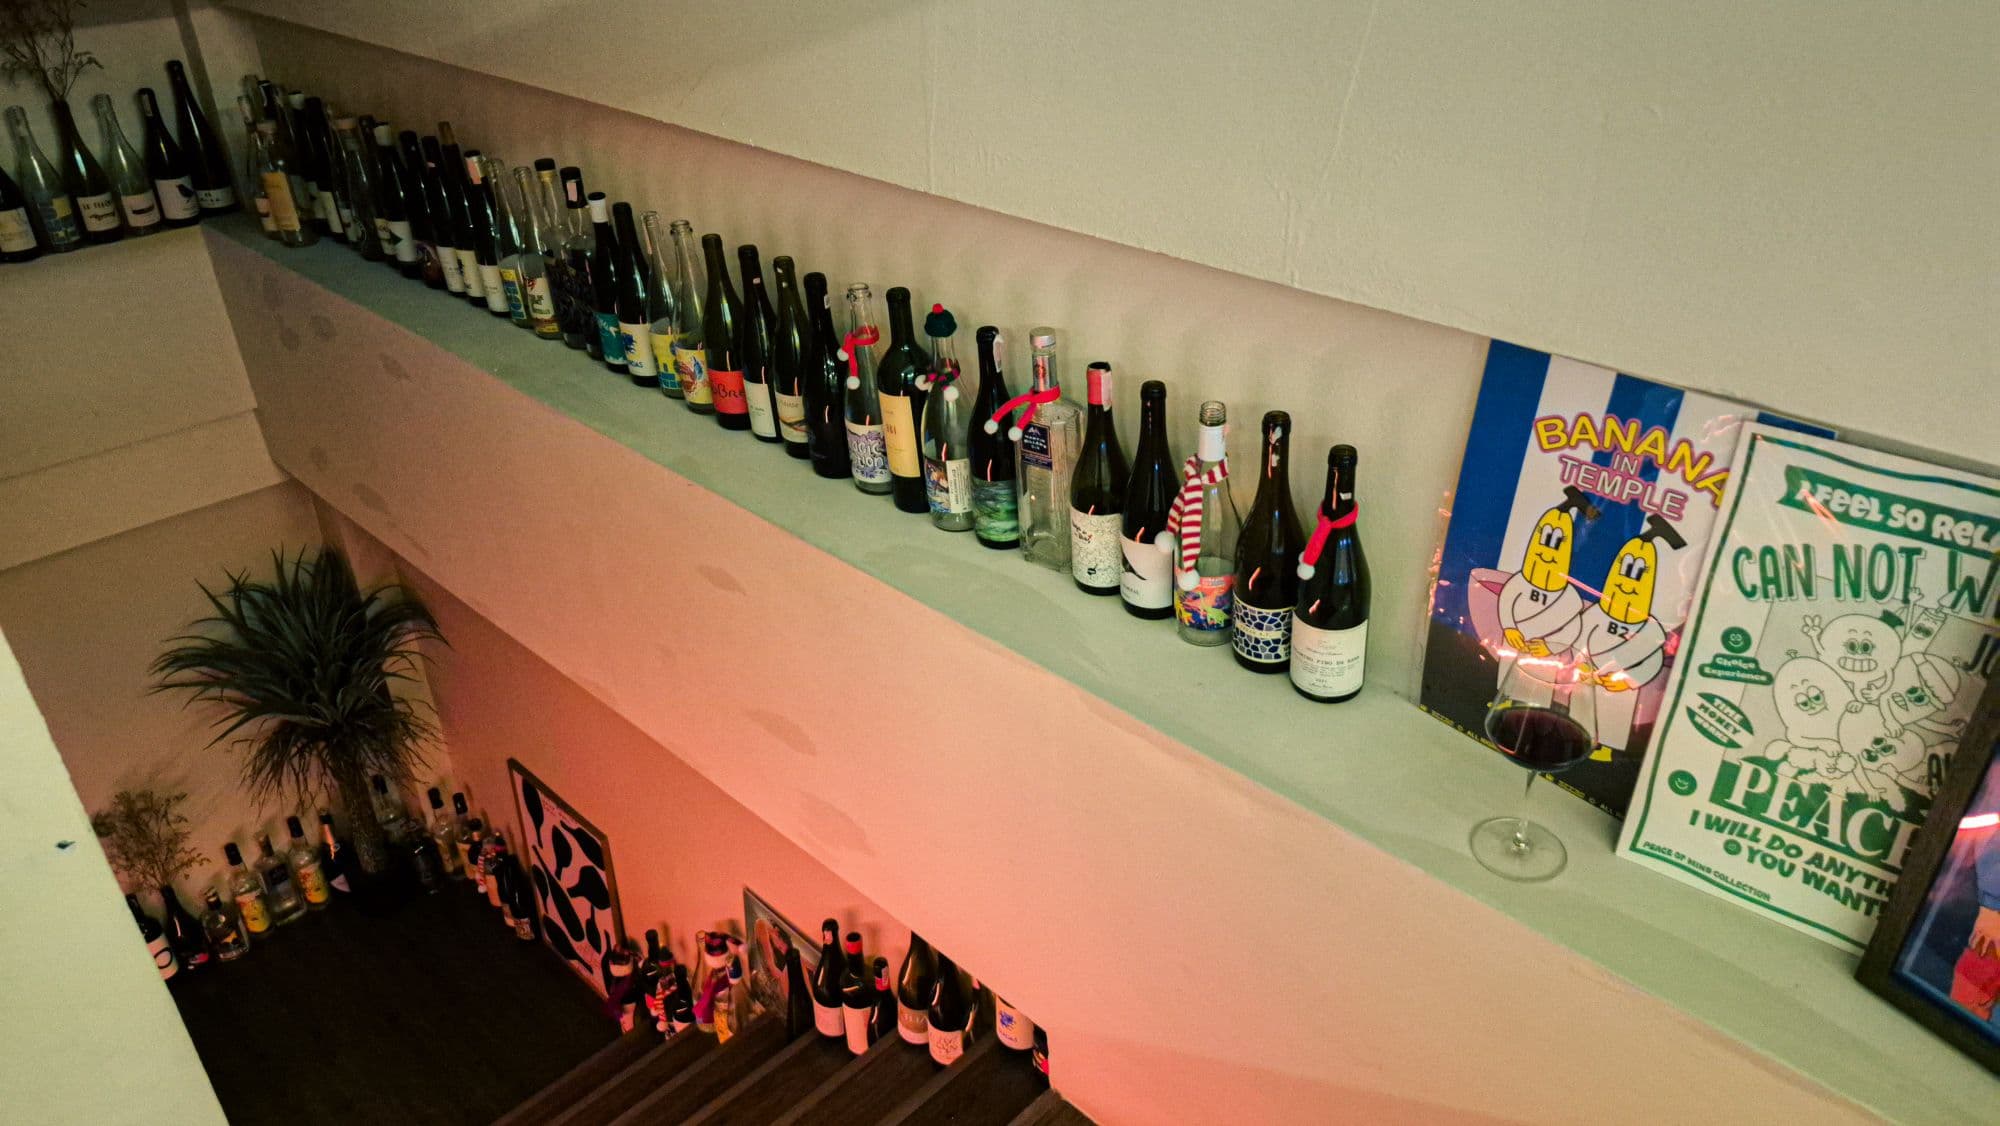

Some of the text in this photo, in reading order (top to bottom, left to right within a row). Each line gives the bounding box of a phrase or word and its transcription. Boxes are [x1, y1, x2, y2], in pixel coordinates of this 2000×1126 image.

[1611, 453, 1640, 477] IN
[1559, 455, 1686, 519] TEMPLE
[1886, 504, 1926, 532] SO
[1732, 543, 1817, 602] CAN
[1831, 543, 1926, 605] NOT
[1530, 589, 1549, 606] B1
[1607, 621, 1630, 639] B2
[1703, 665, 1768, 682] Experience
[1697, 702, 1742, 735] MONEY
[1689, 809, 1701, 826] I
[1704, 812, 1761, 843] WILL
[1765, 833, 1803, 859] DO
[1642, 840, 1673, 857] PEACE
[1713, 869, 1772, 902] COLLECTION
[1746, 845, 1796, 879] YOU
